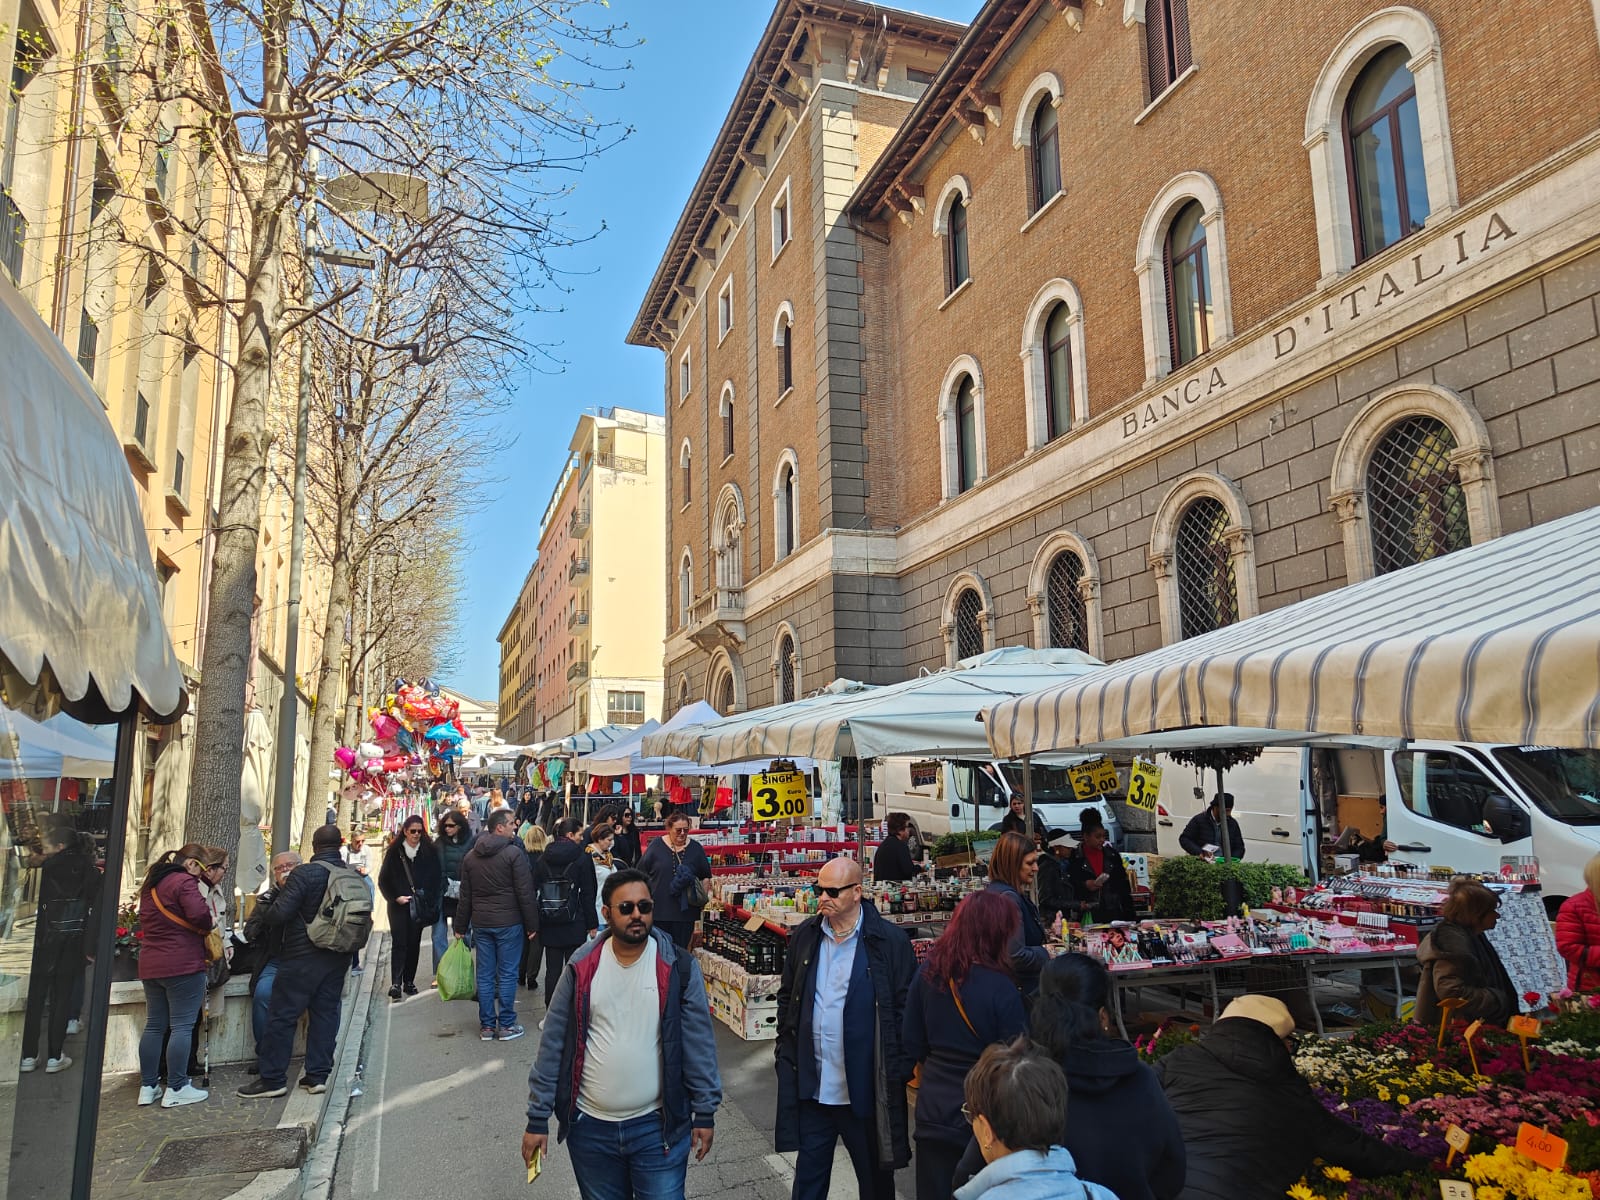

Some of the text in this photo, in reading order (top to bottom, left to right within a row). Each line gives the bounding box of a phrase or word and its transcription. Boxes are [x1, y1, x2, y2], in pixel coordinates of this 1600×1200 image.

[1121, 212, 1518, 439] BANCA D'ITALIA
[762, 774, 793, 785] SINGH
[1075, 775, 1117, 796] 3.00
[1130, 774, 1157, 810] 3.00
[756, 787, 805, 818] 3.00
